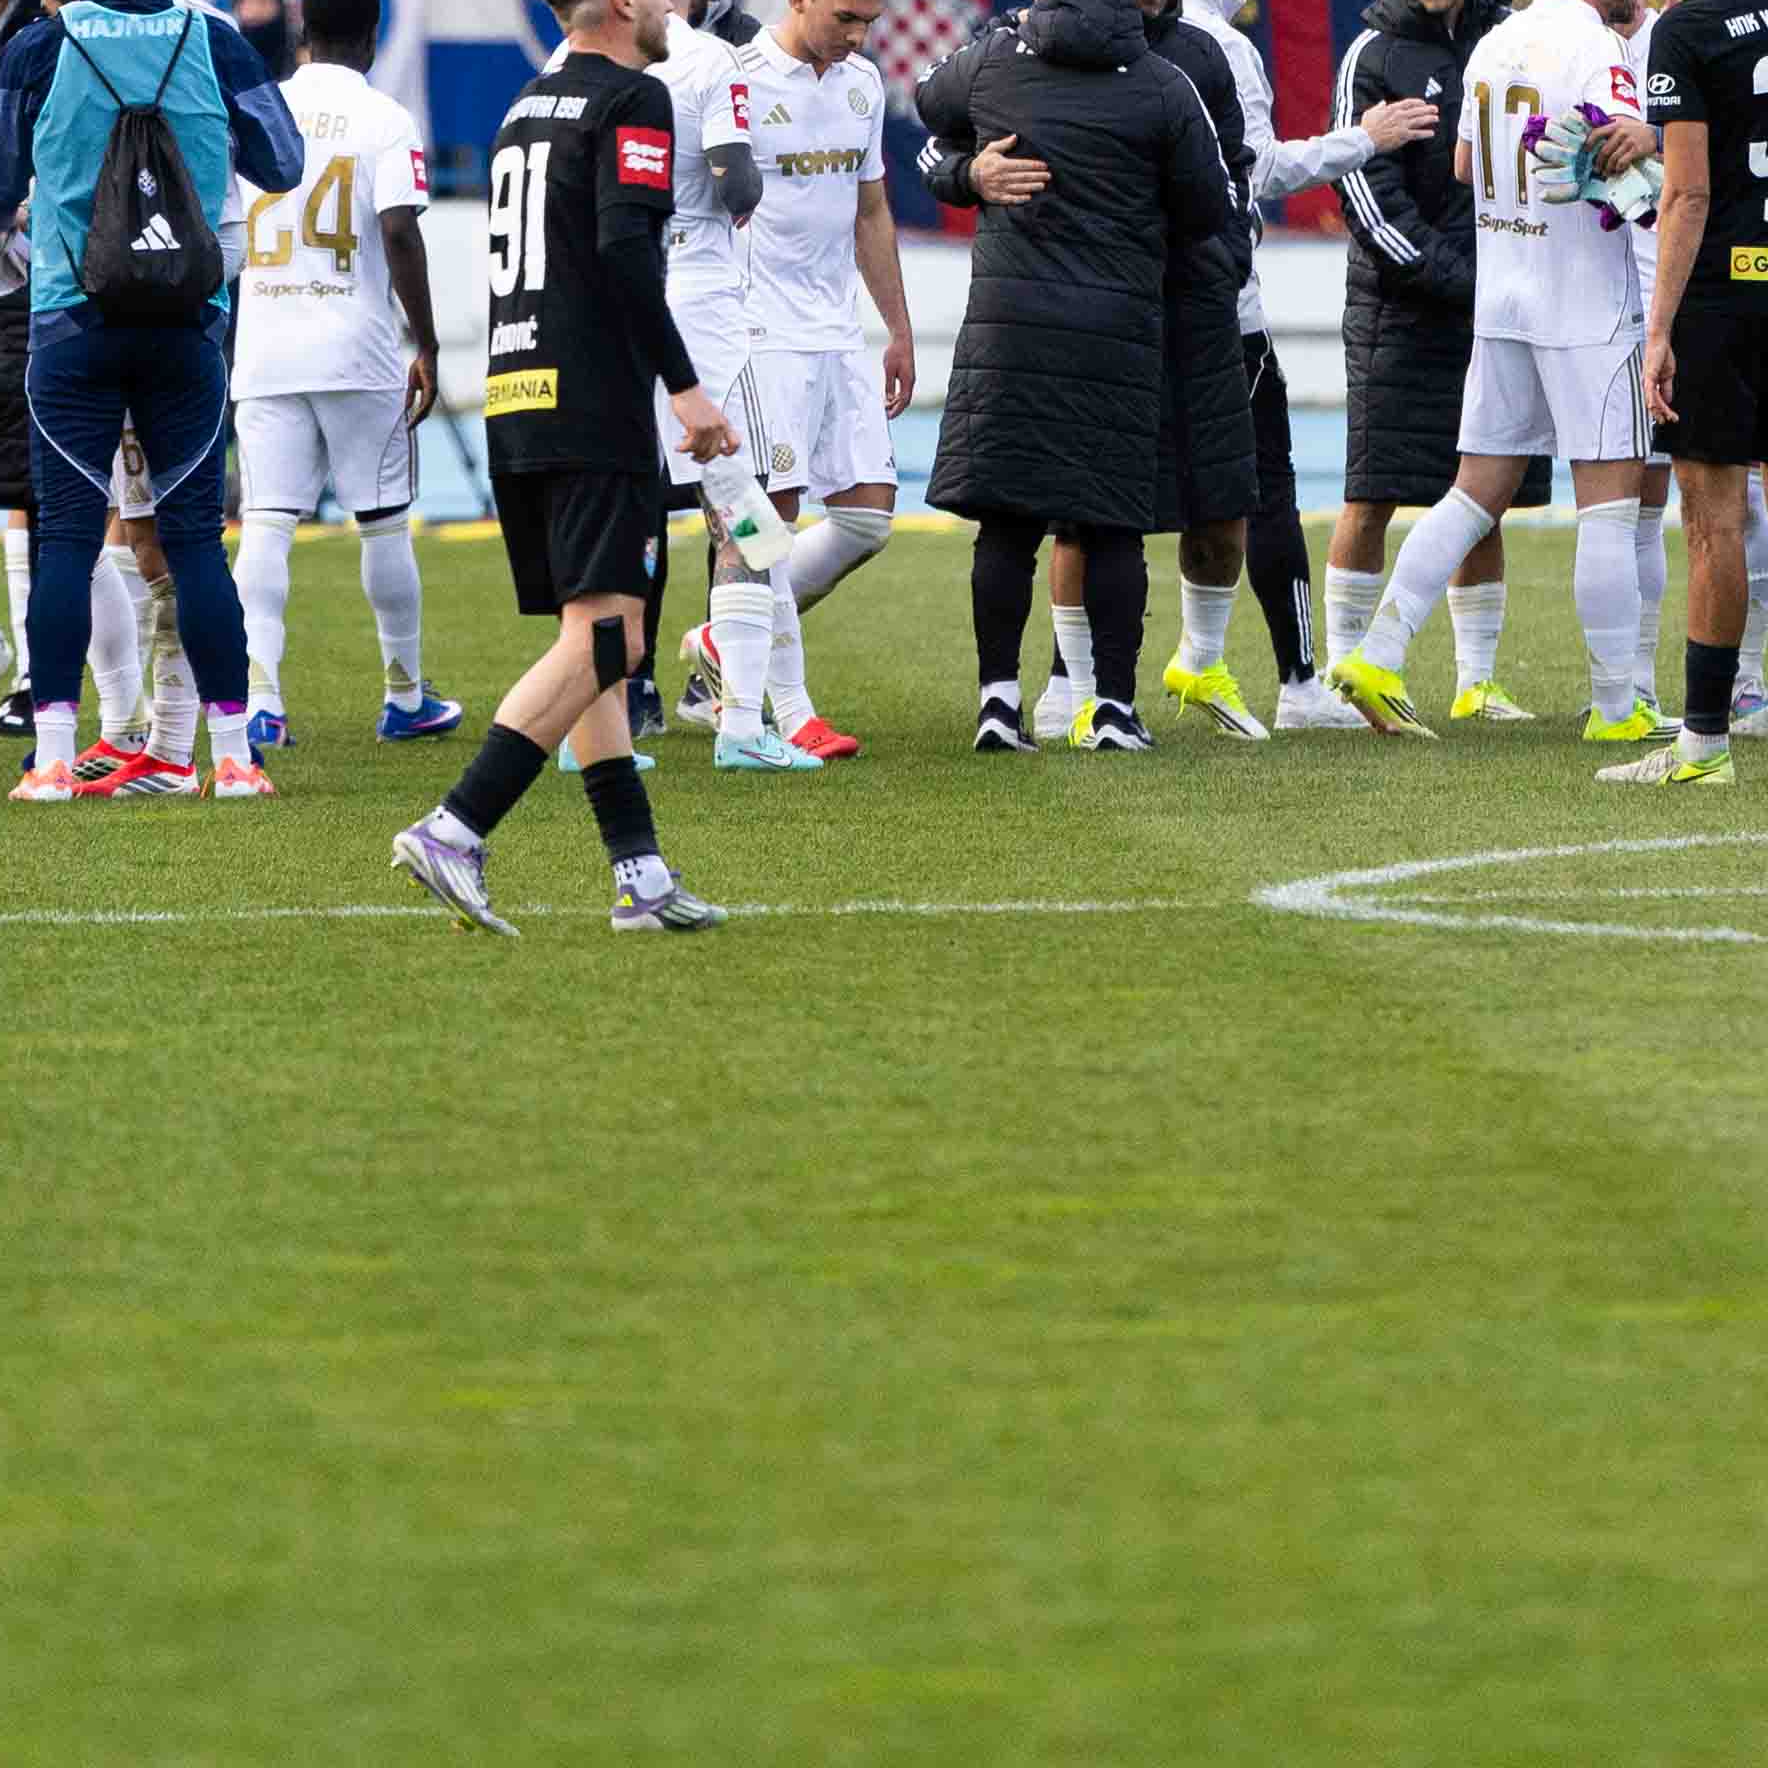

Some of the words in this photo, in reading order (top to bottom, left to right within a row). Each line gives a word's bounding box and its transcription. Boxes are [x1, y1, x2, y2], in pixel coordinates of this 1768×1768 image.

[71, 16, 185, 39] HAJDUK
[1725, 15, 1761, 38] HNK
[1473, 81, 1542, 206] 17
[775, 148, 869, 177] TOMMY
[247, 154, 359, 273] 24
[489, 141, 552, 297] 91
[1477, 212, 1550, 237] SuperSport
[252, 279, 362, 309] SuperSport
[487, 379, 554, 405] ERMANIA
